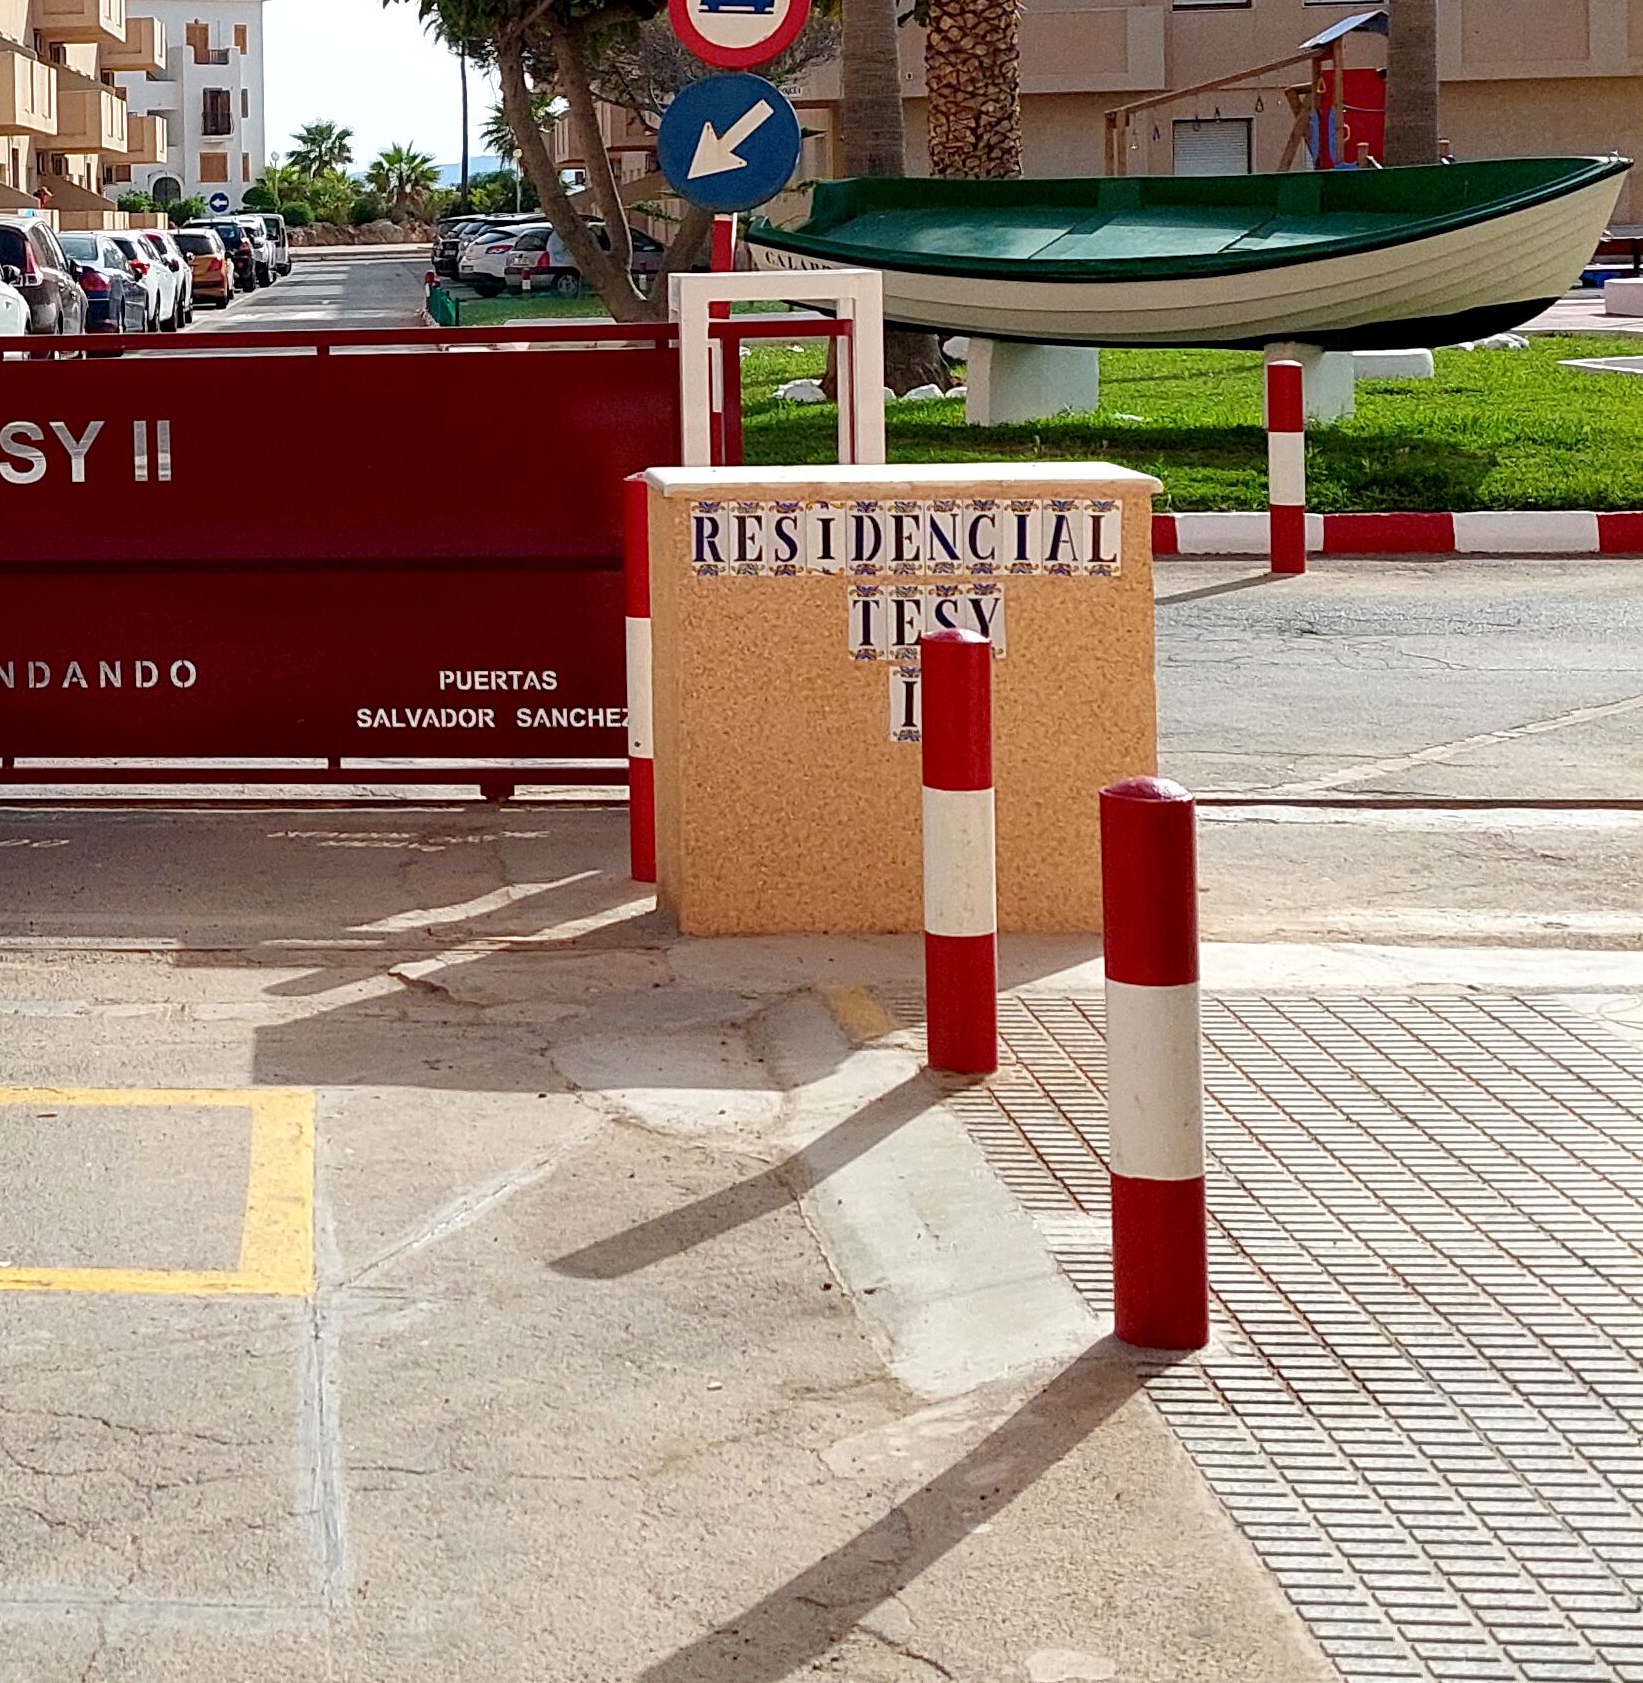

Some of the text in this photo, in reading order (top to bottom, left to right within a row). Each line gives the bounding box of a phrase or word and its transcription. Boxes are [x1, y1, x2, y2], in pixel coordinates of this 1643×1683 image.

[133, 419, 172, 482] II
[693, 513, 1119, 565] RESIDENCIAL
[439, 670, 558, 691] PUERTAS
[357, 708, 496, 729] SALVADOR
